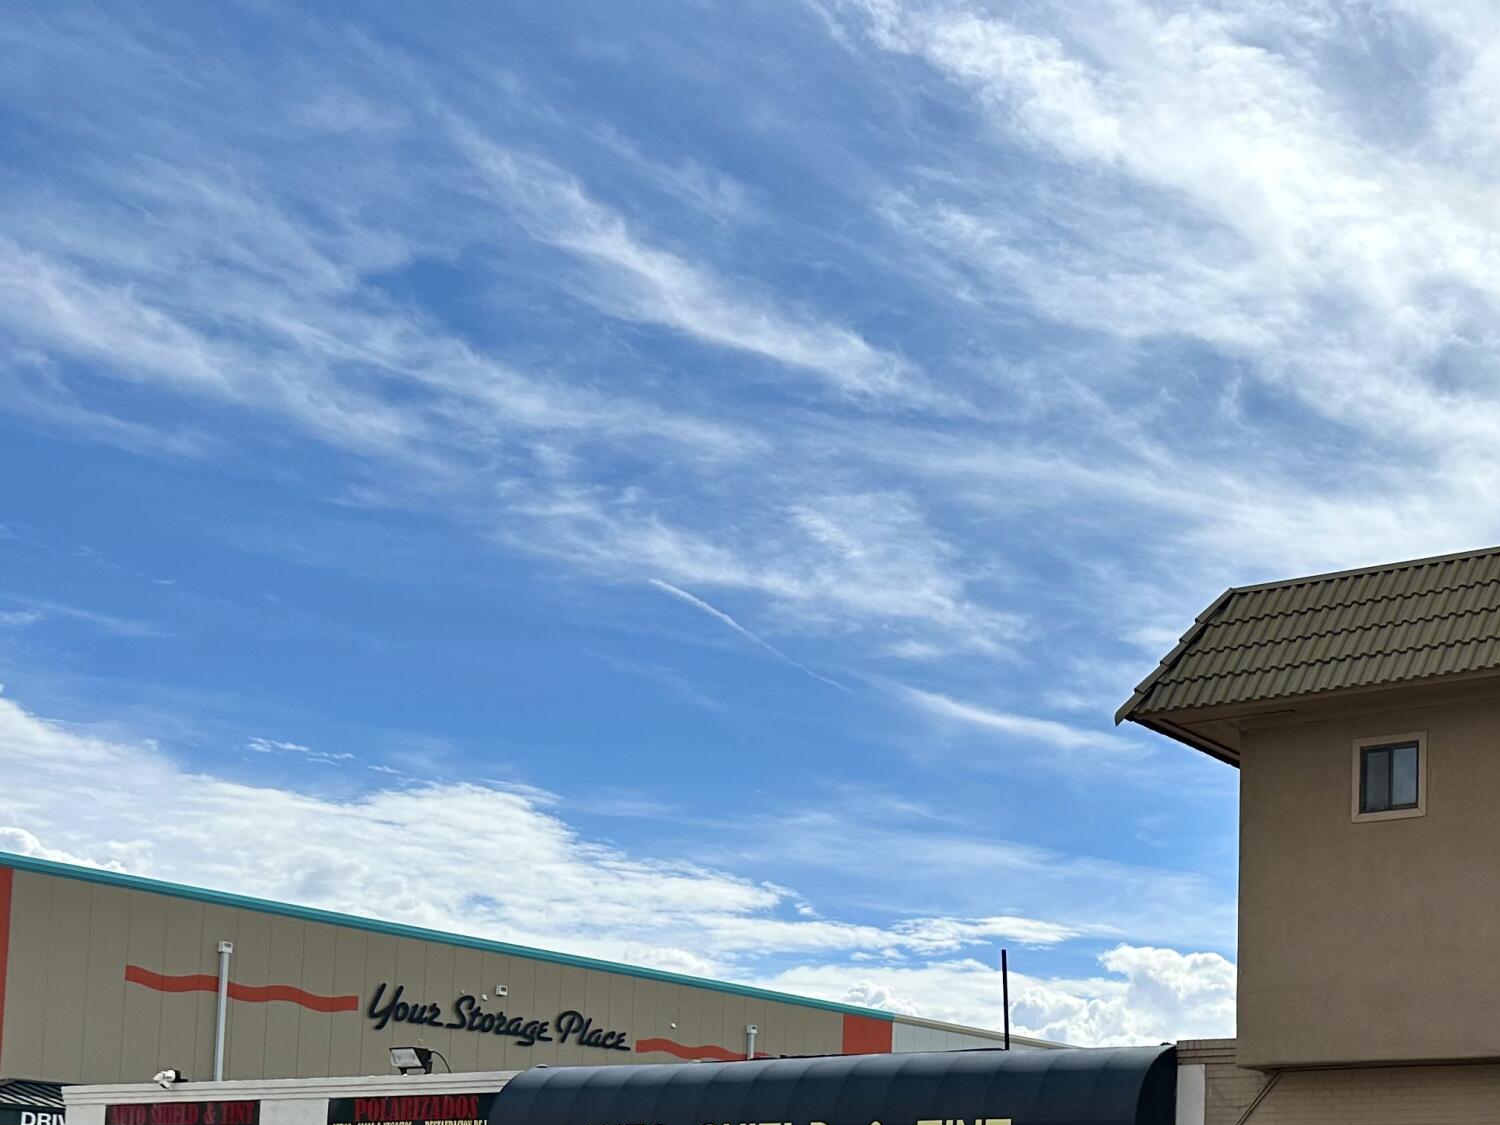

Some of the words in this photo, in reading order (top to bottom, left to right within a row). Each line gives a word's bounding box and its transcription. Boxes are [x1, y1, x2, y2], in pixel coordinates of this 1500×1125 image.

[368, 983, 444, 1030] Your
[446, 995, 553, 1046] Storage
[556, 1010, 631, 1051] Place
[151, 1103, 199, 1125] SHIELD
[204, 1103, 216, 1124] &
[221, 1102, 255, 1124] TINT
[354, 1095, 479, 1121] POLARIZADOS
